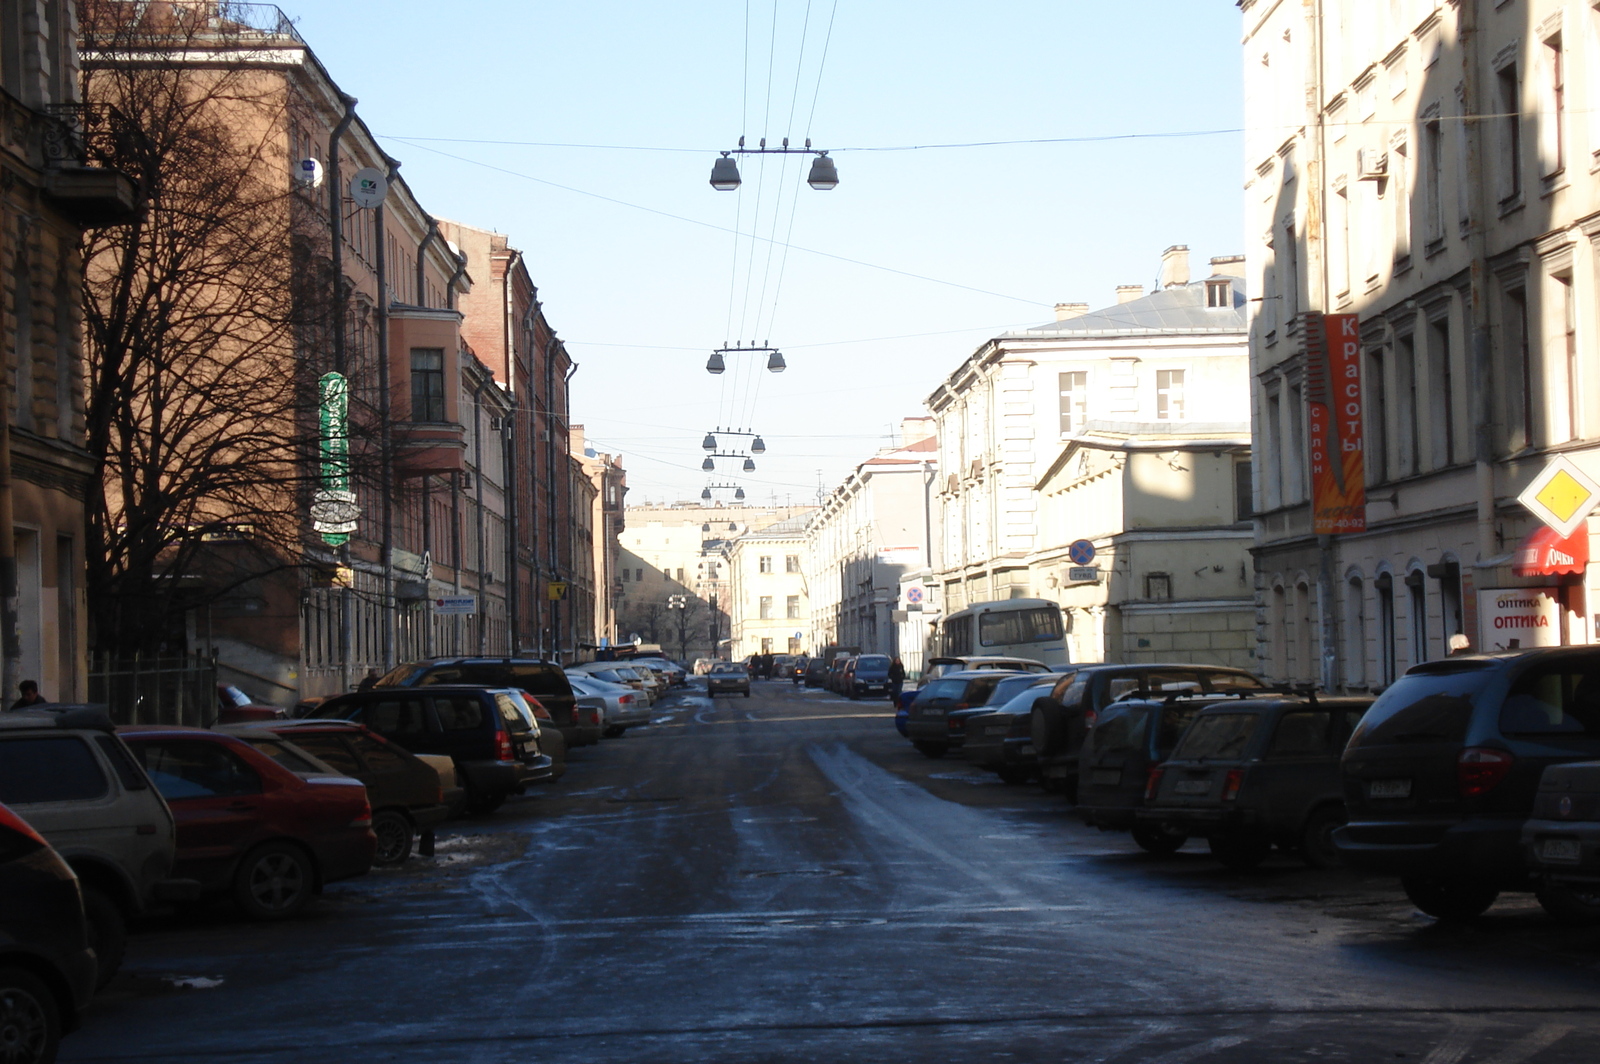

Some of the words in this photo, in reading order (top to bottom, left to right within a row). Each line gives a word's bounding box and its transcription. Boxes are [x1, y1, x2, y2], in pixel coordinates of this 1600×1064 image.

[1341, 317, 1362, 452] Красоты
[1311, 407, 1322, 474] Салон
[1315, 518, 1365, 529] 272-40-92
[1497, 597, 1541, 609] ОПТИКА
[1493, 614, 1549, 630] ОПТИКА
